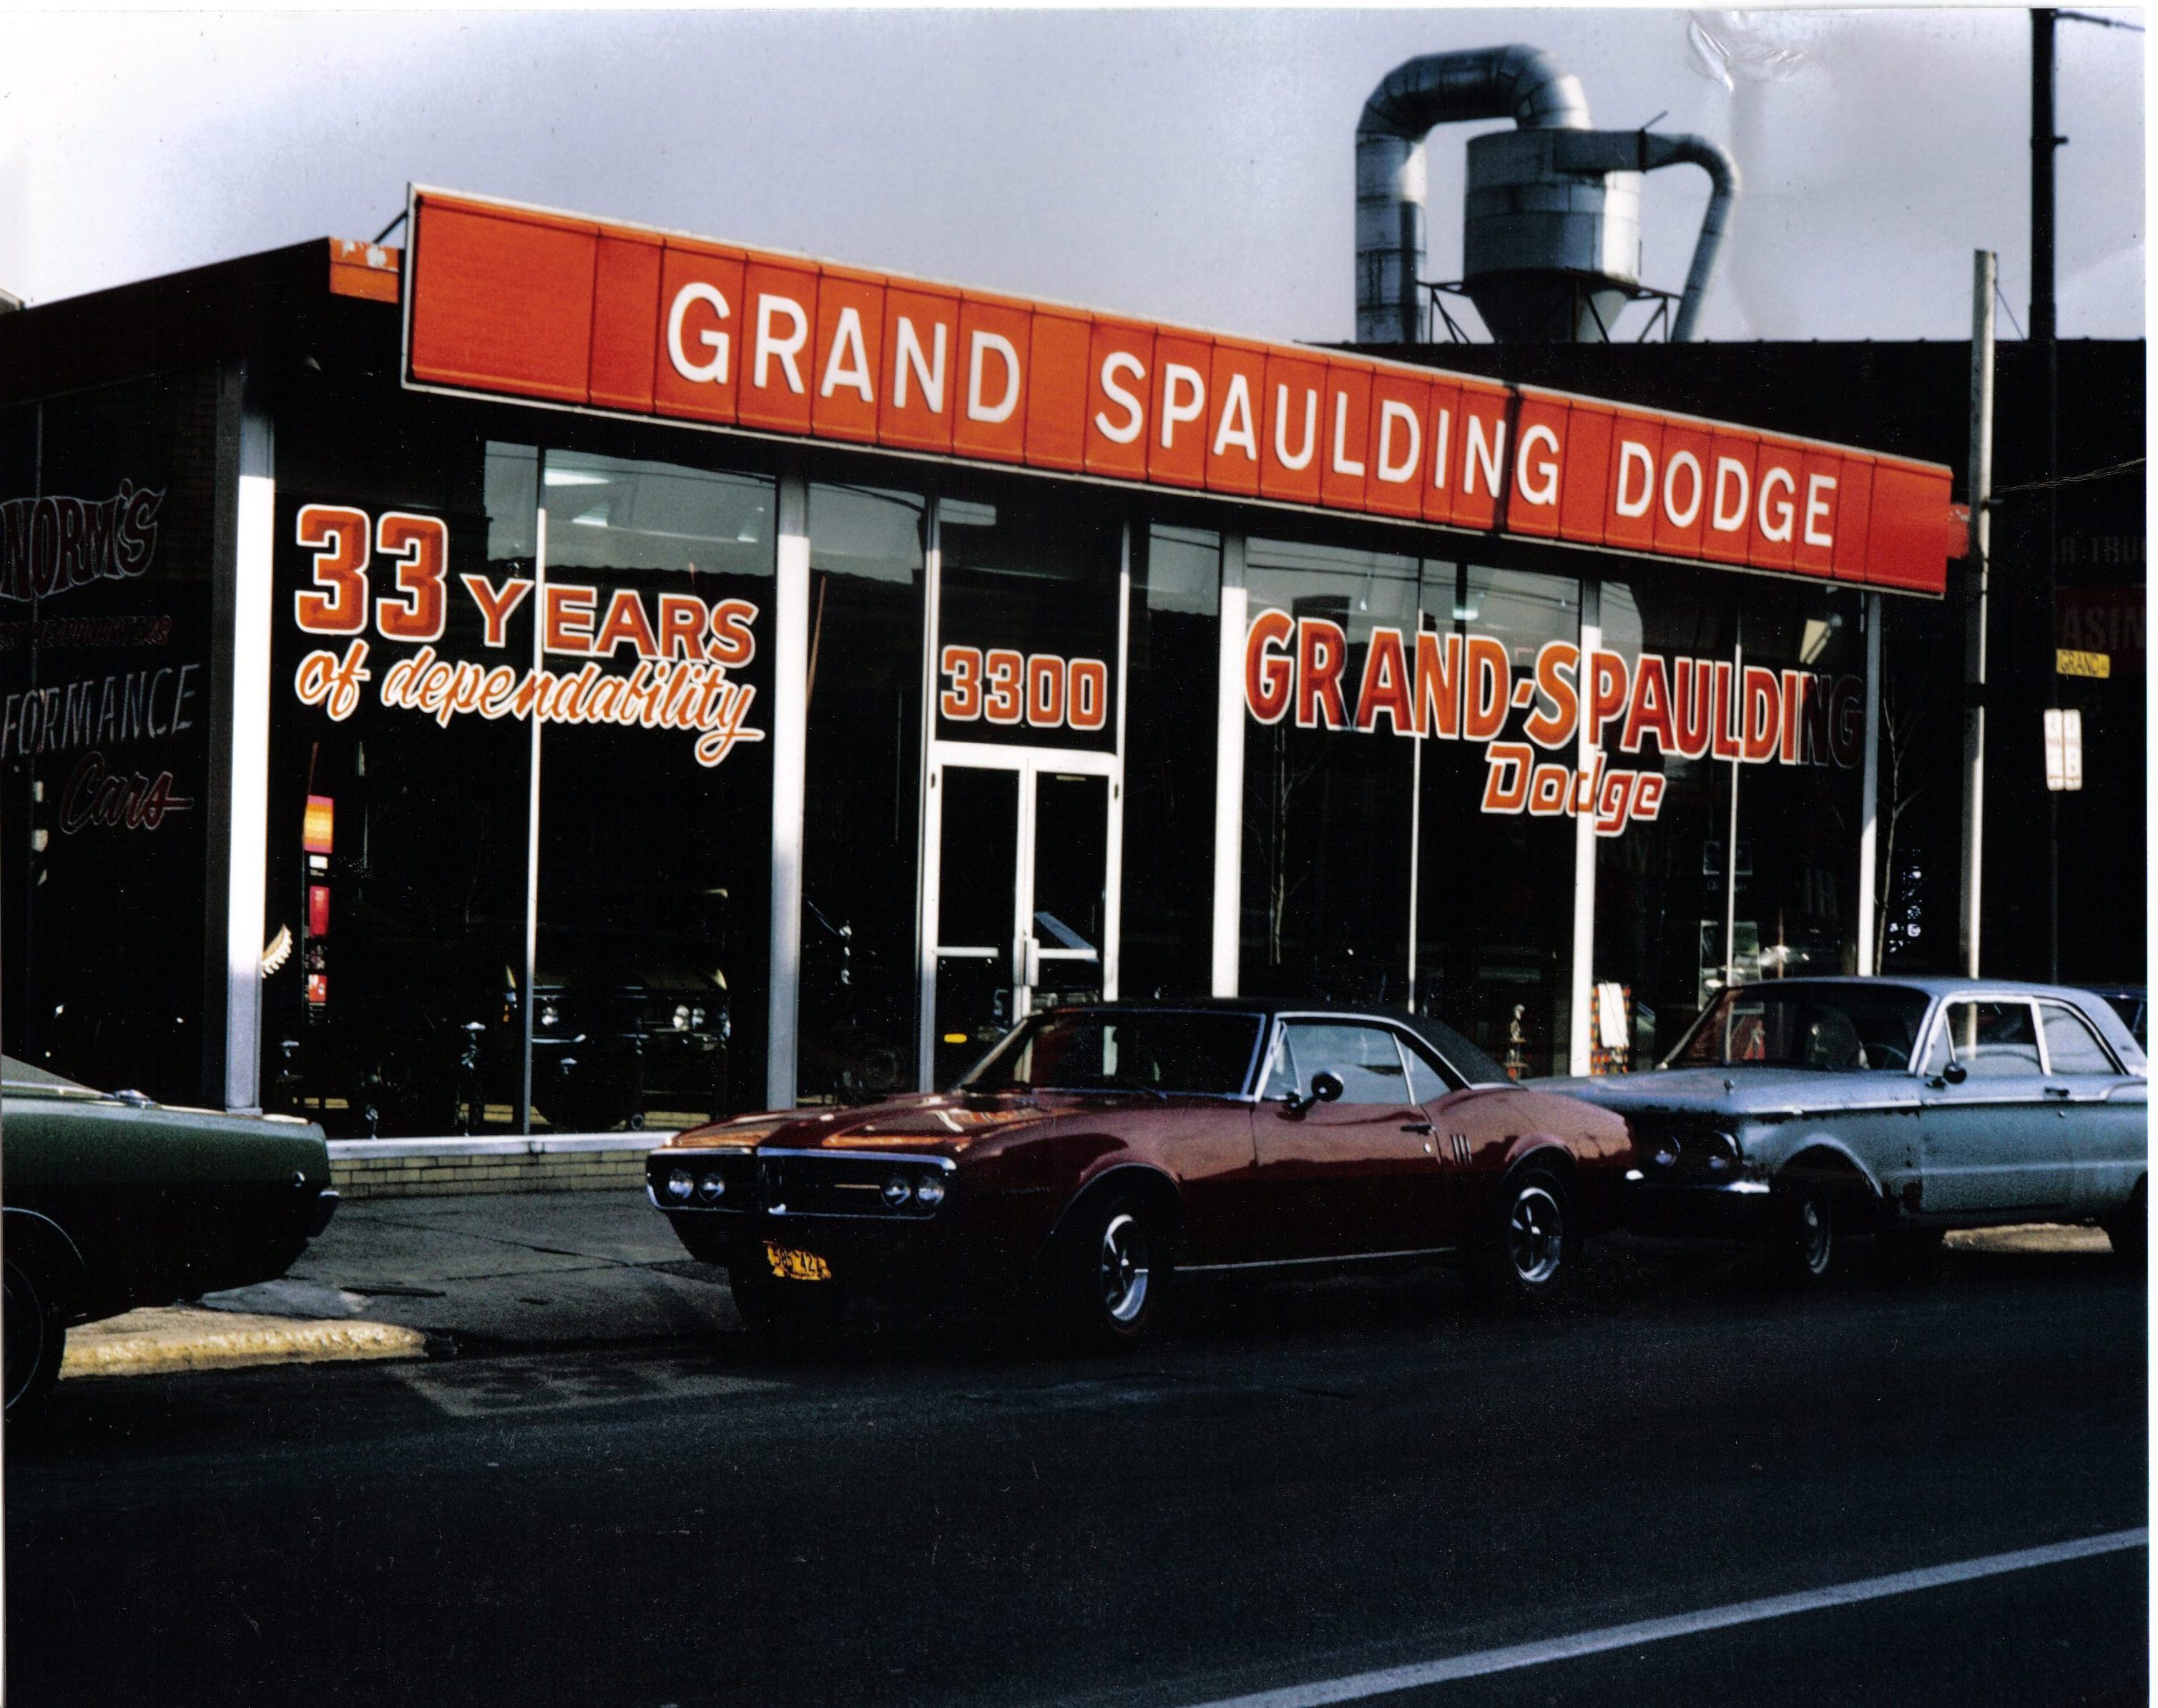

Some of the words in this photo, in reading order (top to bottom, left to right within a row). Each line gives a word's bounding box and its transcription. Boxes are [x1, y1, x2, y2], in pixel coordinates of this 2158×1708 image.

[667, 281, 1021, 424] GRAND
[1094, 351, 1560, 506] SPAULDING
[1615, 440, 1837, 547] DODGE
[0, 477, 167, 602] NORM'S
[295, 504, 448, 642] 33
[459, 573, 760, 669] YEARS
[1, 663, 201, 760] FORMANCE
[295, 638, 371, 722] of
[381, 645, 766, 767] dependability
[941, 644, 1108, 732] 3300
[1245, 607, 1866, 770] GRAND-SPAULDING
[59, 750, 195, 835] Cars
[1479, 741, 1667, 839] Dodge
